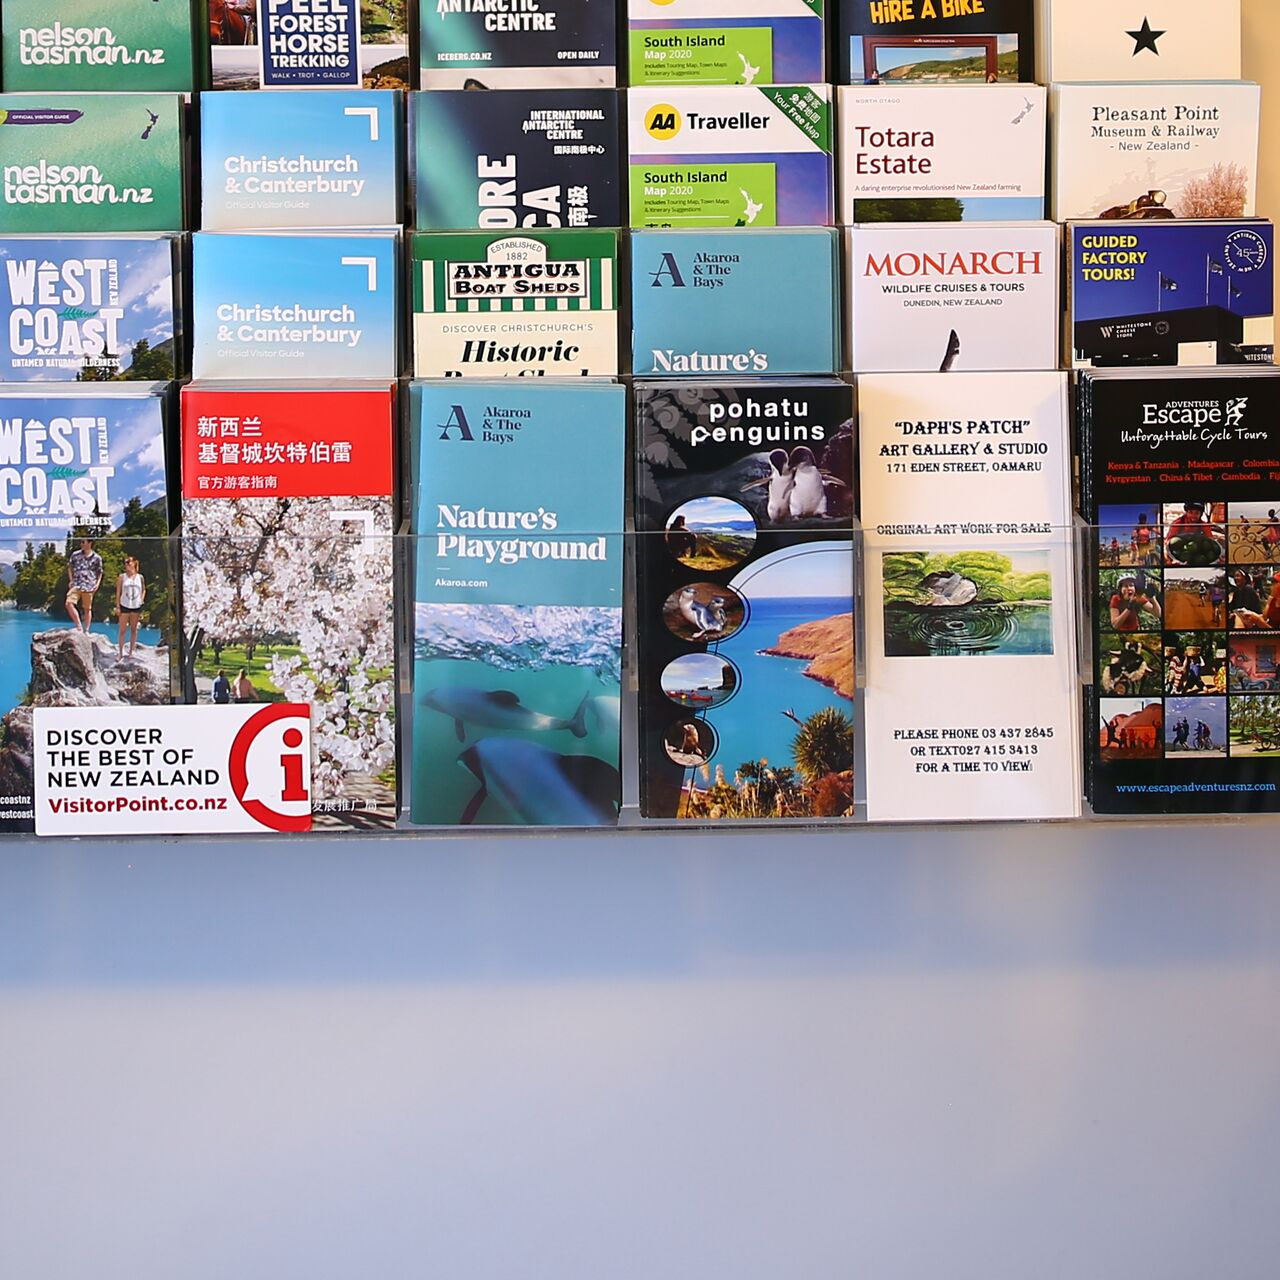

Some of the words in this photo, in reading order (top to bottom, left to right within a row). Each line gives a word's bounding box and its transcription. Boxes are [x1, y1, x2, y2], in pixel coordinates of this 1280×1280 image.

[269, 15, 347, 33] FOREST
[485, 13, 557, 31] CENTRE
[270, 34, 349, 53] HORSE
[271, 55, 350, 68] TREKKING
[557, 51, 579, 60] OPEN
[581, 51, 599, 60] DAILY
[1092, 106, 1167, 122] Pleasant
[1174, 105, 1220, 121] Point
[855, 126, 935, 148] Totara
[224, 155, 358, 175] Christchurch
[855, 153, 931, 175] Estate
[225, 178, 241, 193] &
[245, 176, 365, 198] Canterbury
[1082, 236, 1138, 249] GUIDED
[863, 251, 1042, 277] MONARCH
[1082, 252, 1147, 265] FACTORY
[453, 263, 580, 280] ANTIGUA
[1082, 268, 1135, 280] TOURS!
[882, 283, 932, 293] WILDLIFE
[934, 283, 978, 293] CRUISES
[980, 283, 987, 292] &
[990, 283, 1025, 292] TOURS
[903, 298, 942, 308] DUNEDIN,
[944, 298, 963, 307] NEW
[965, 298, 1002, 306] ZEALAND
[442, 324, 497, 333] DISCOVER
[709, 398, 808, 421] pohatu
[1143, 404, 1222, 428] Escape
[196, 416, 263, 438] 新西兰
[690, 423, 826, 446] penguins
[198, 441, 352, 464] 基督城坎特伯雷
[197, 475, 278, 490] 官方游客指南
[436, 536, 606, 565] Playground
[46, 729, 163, 746] DISCOVER
[47, 750, 89, 766] THE
[99, 749, 152, 766] BEST
[163, 748, 194, 765] OF
[48, 771, 101, 787] NEW
[110, 769, 219, 785] ZEALAND
[1116, 781, 1276, 794] www.escapeadventuresnz.com
[48, 795, 228, 814] VisitorPoint.co.nz
